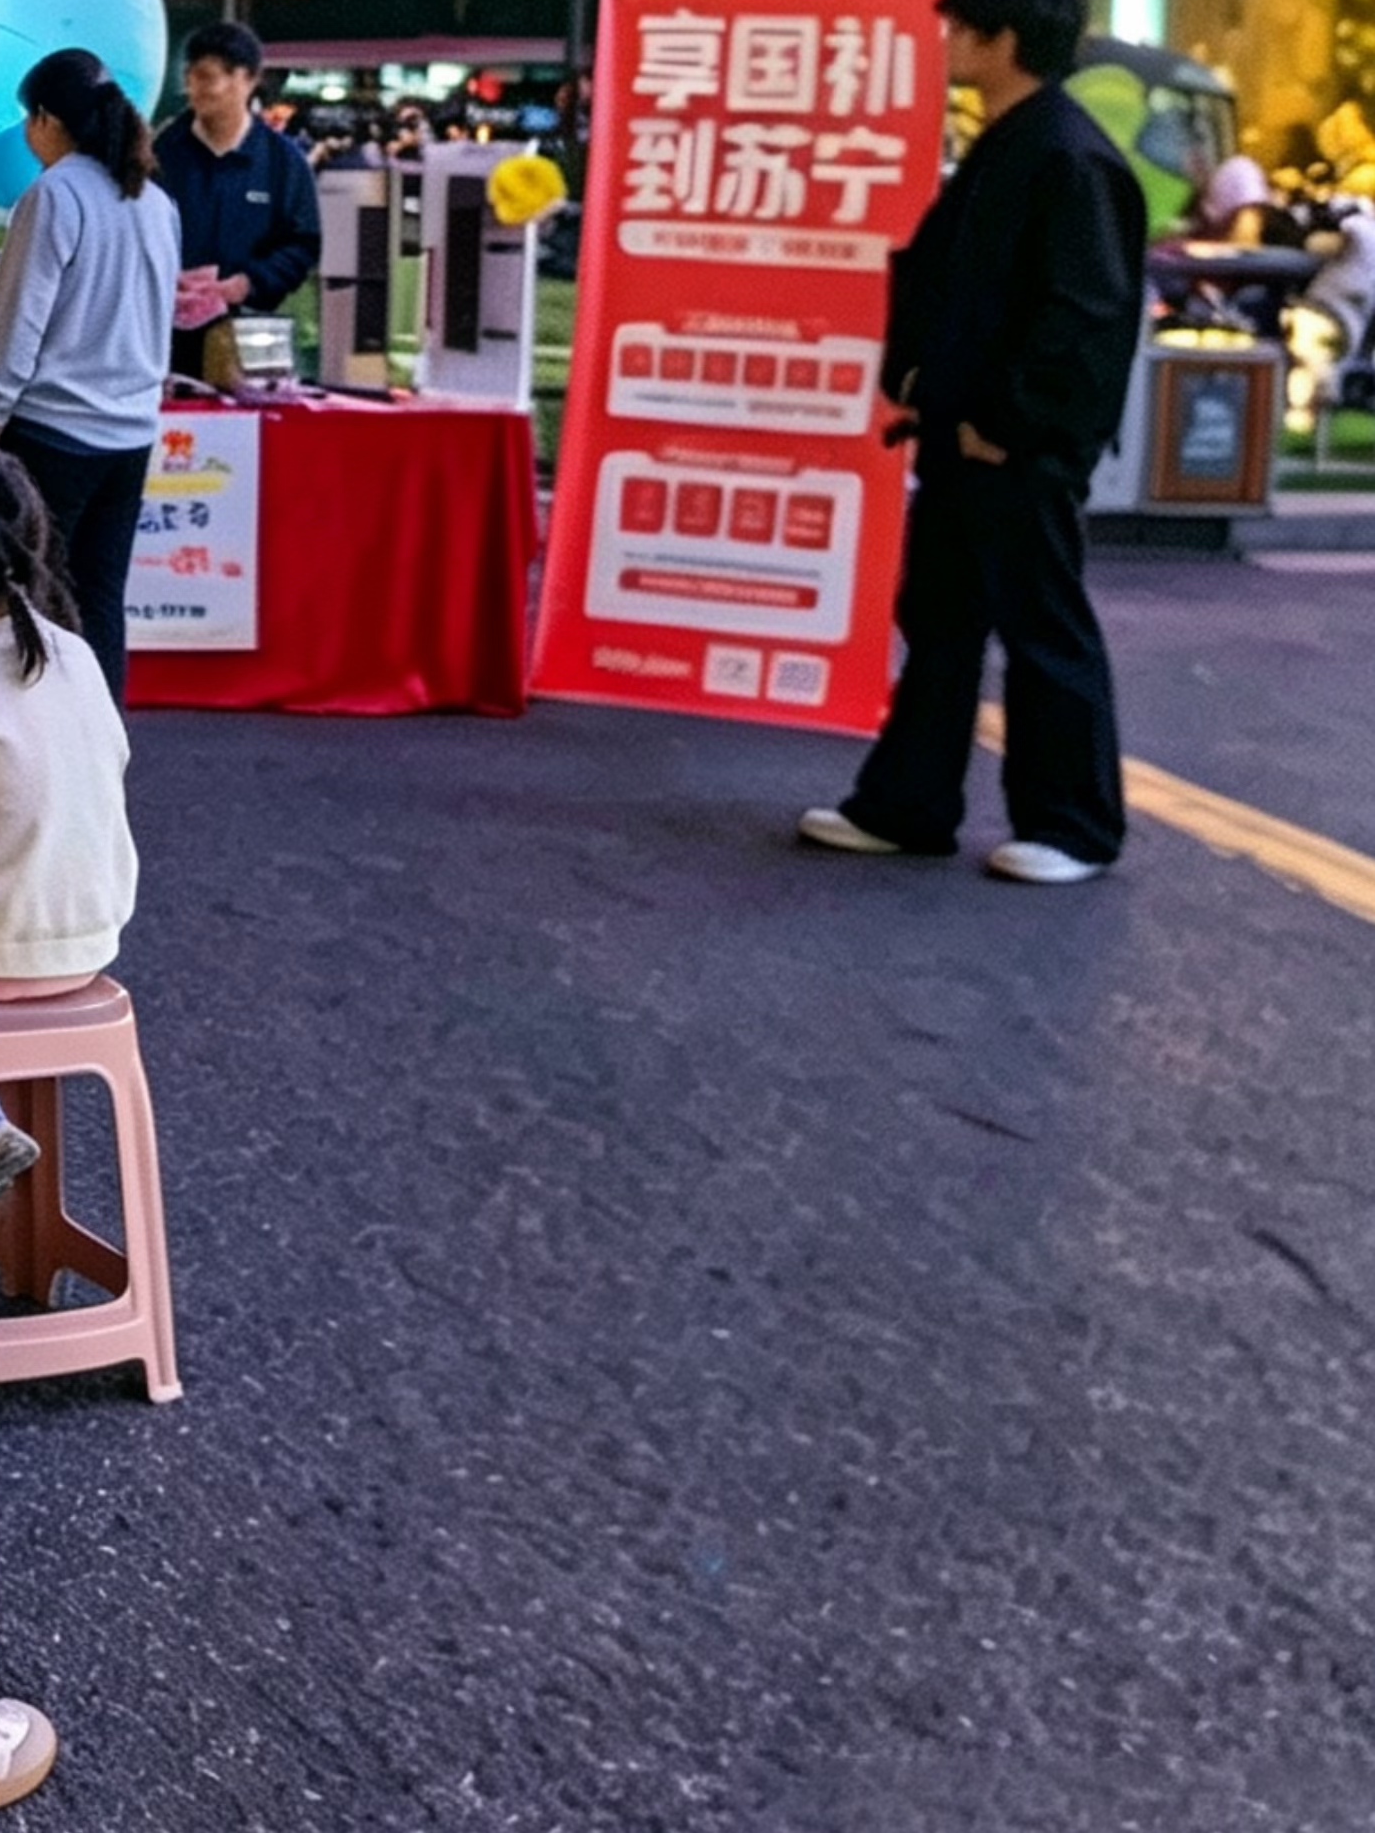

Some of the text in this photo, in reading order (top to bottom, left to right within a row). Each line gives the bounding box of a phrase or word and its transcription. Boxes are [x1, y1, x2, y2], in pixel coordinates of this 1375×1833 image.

[631, 7, 917, 117] 享国补
[622, 118, 908, 225] 到苏宁
